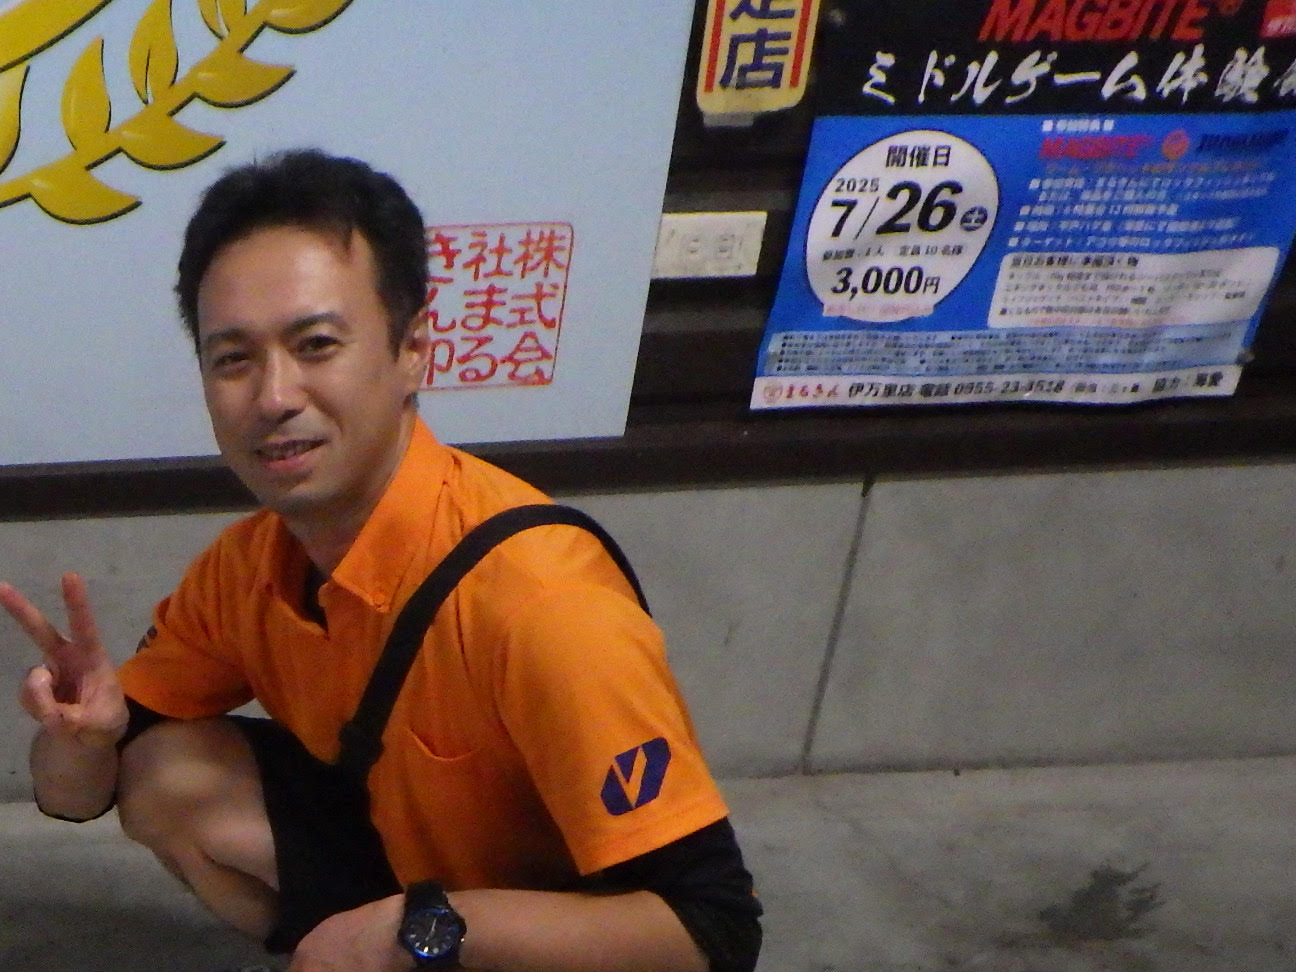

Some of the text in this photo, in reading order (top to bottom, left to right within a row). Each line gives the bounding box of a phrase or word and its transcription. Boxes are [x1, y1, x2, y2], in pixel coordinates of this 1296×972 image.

[885, 144, 952, 168] 開催日
[835, 177, 880, 193] 2025
[830, 180, 963, 241] 7/26
[830, 265, 941, 302] 3,000円
